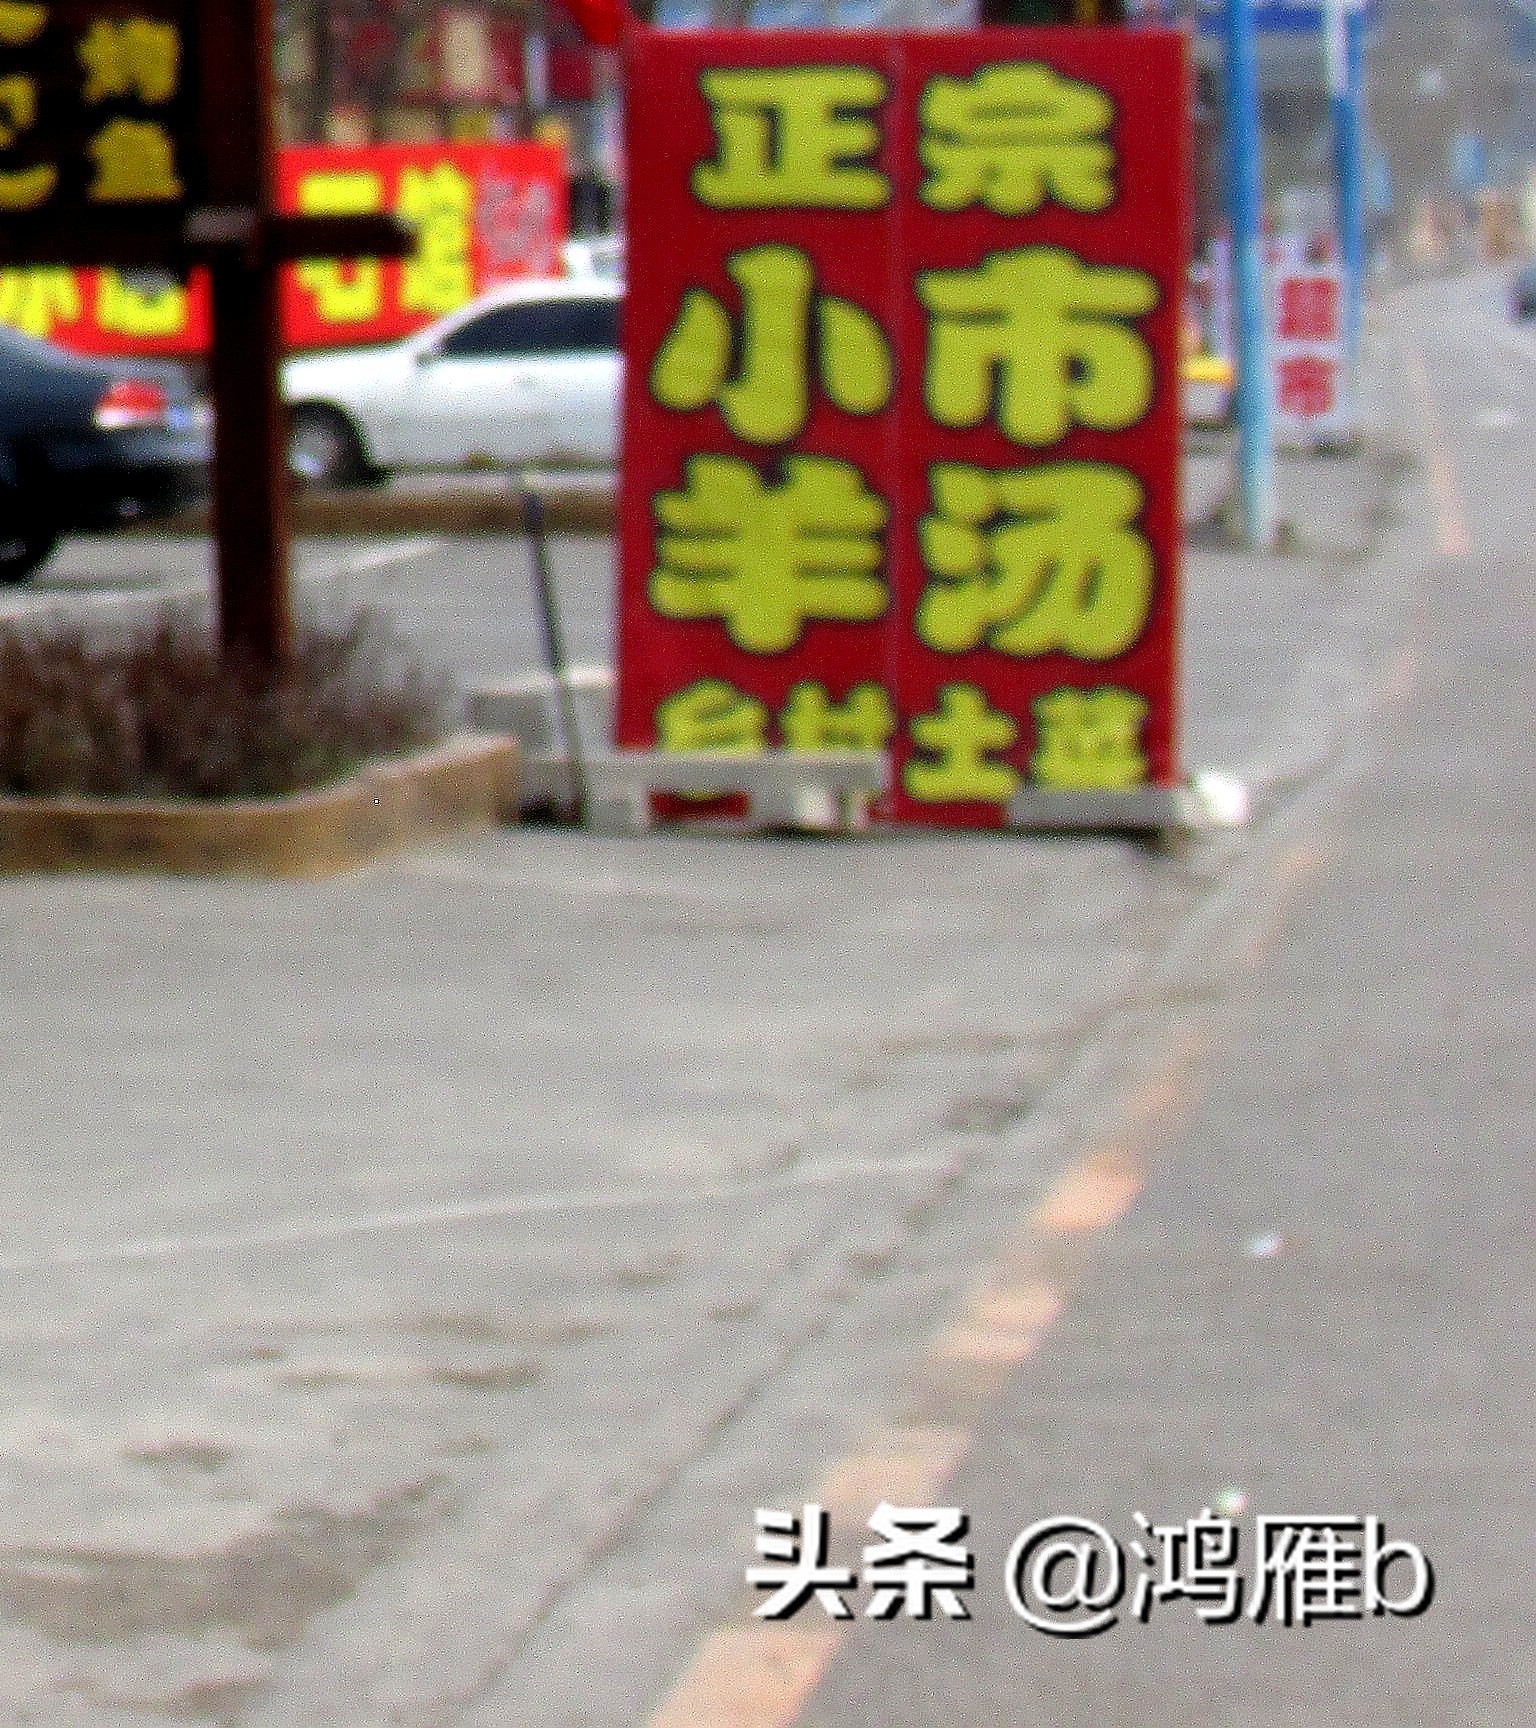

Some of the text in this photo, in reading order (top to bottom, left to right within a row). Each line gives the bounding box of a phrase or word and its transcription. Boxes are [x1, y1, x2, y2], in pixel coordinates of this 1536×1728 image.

[691, 60, 1117, 215] 正宗
[652, 244, 1161, 447] 小市
[648, 452, 1156, 661] 羊汤
